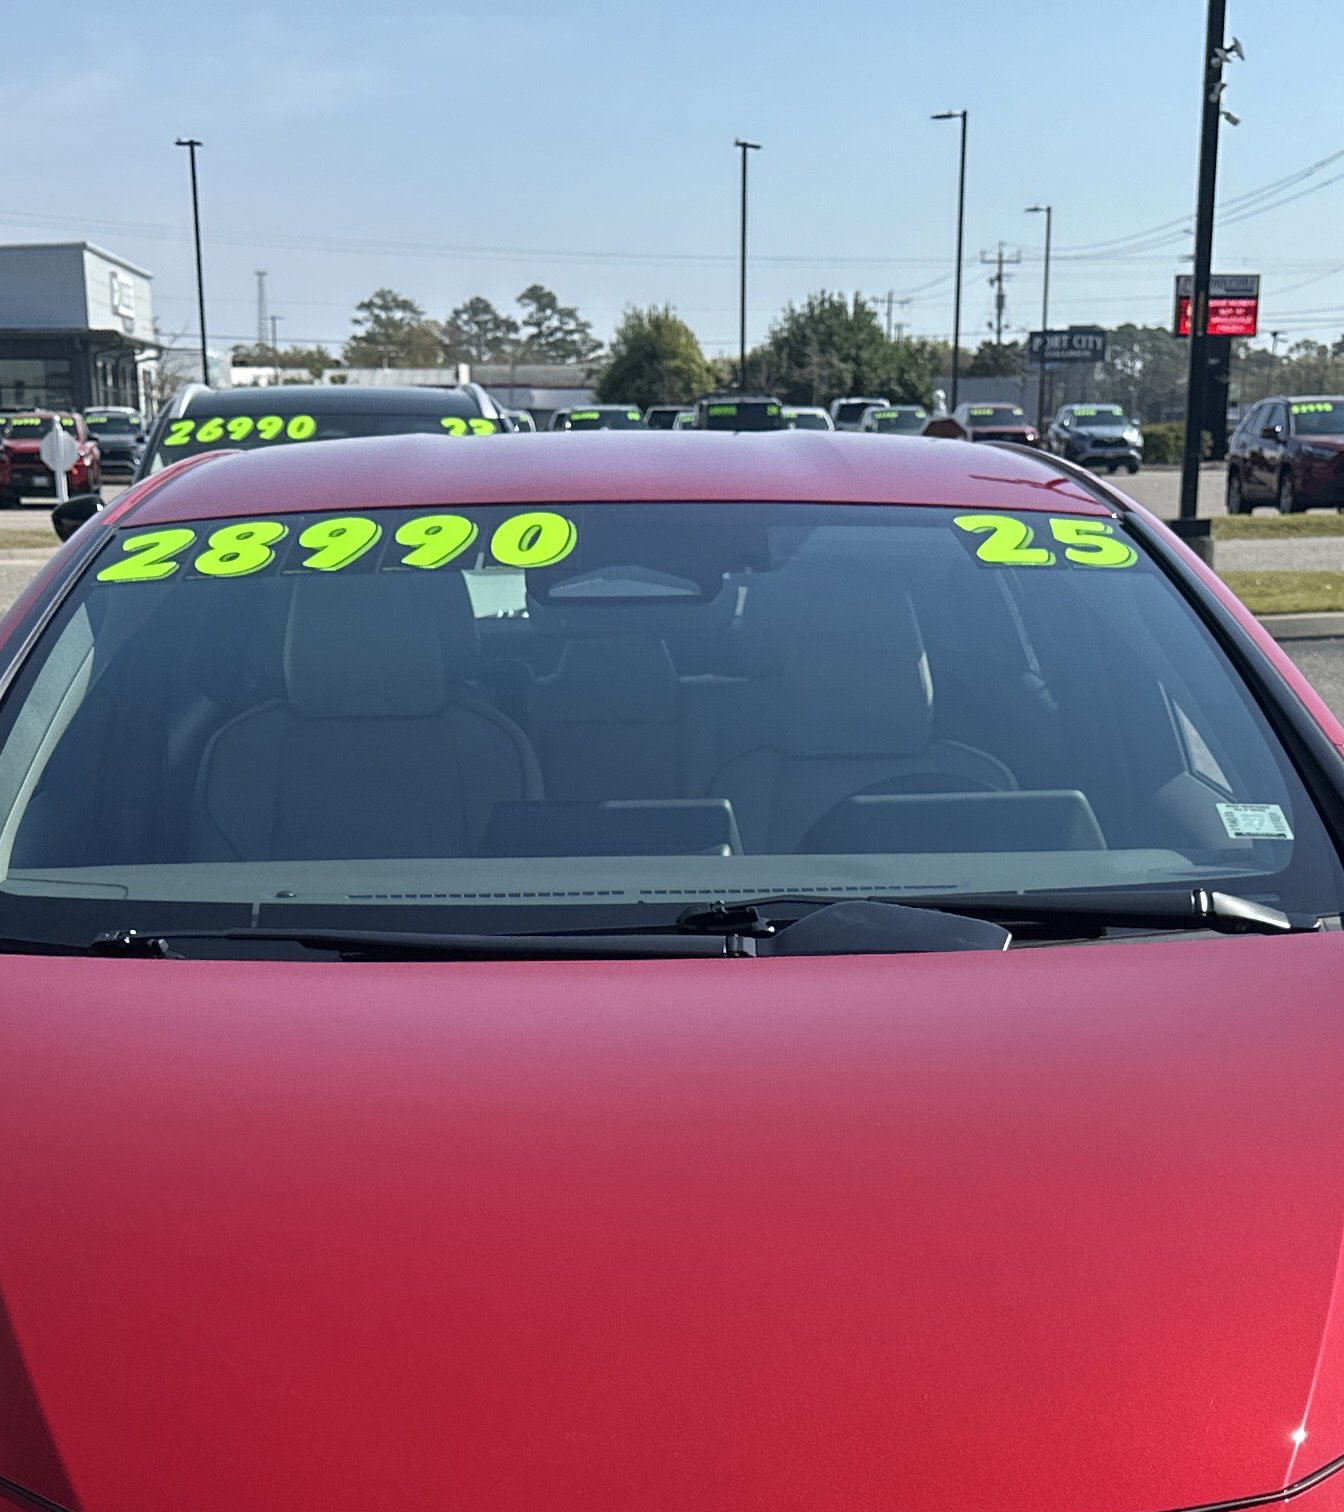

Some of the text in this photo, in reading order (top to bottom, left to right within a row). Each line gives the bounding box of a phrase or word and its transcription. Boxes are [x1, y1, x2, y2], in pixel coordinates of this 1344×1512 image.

[164, 415, 317, 446] 26990
[96, 512, 1138, 583] 28990 25
